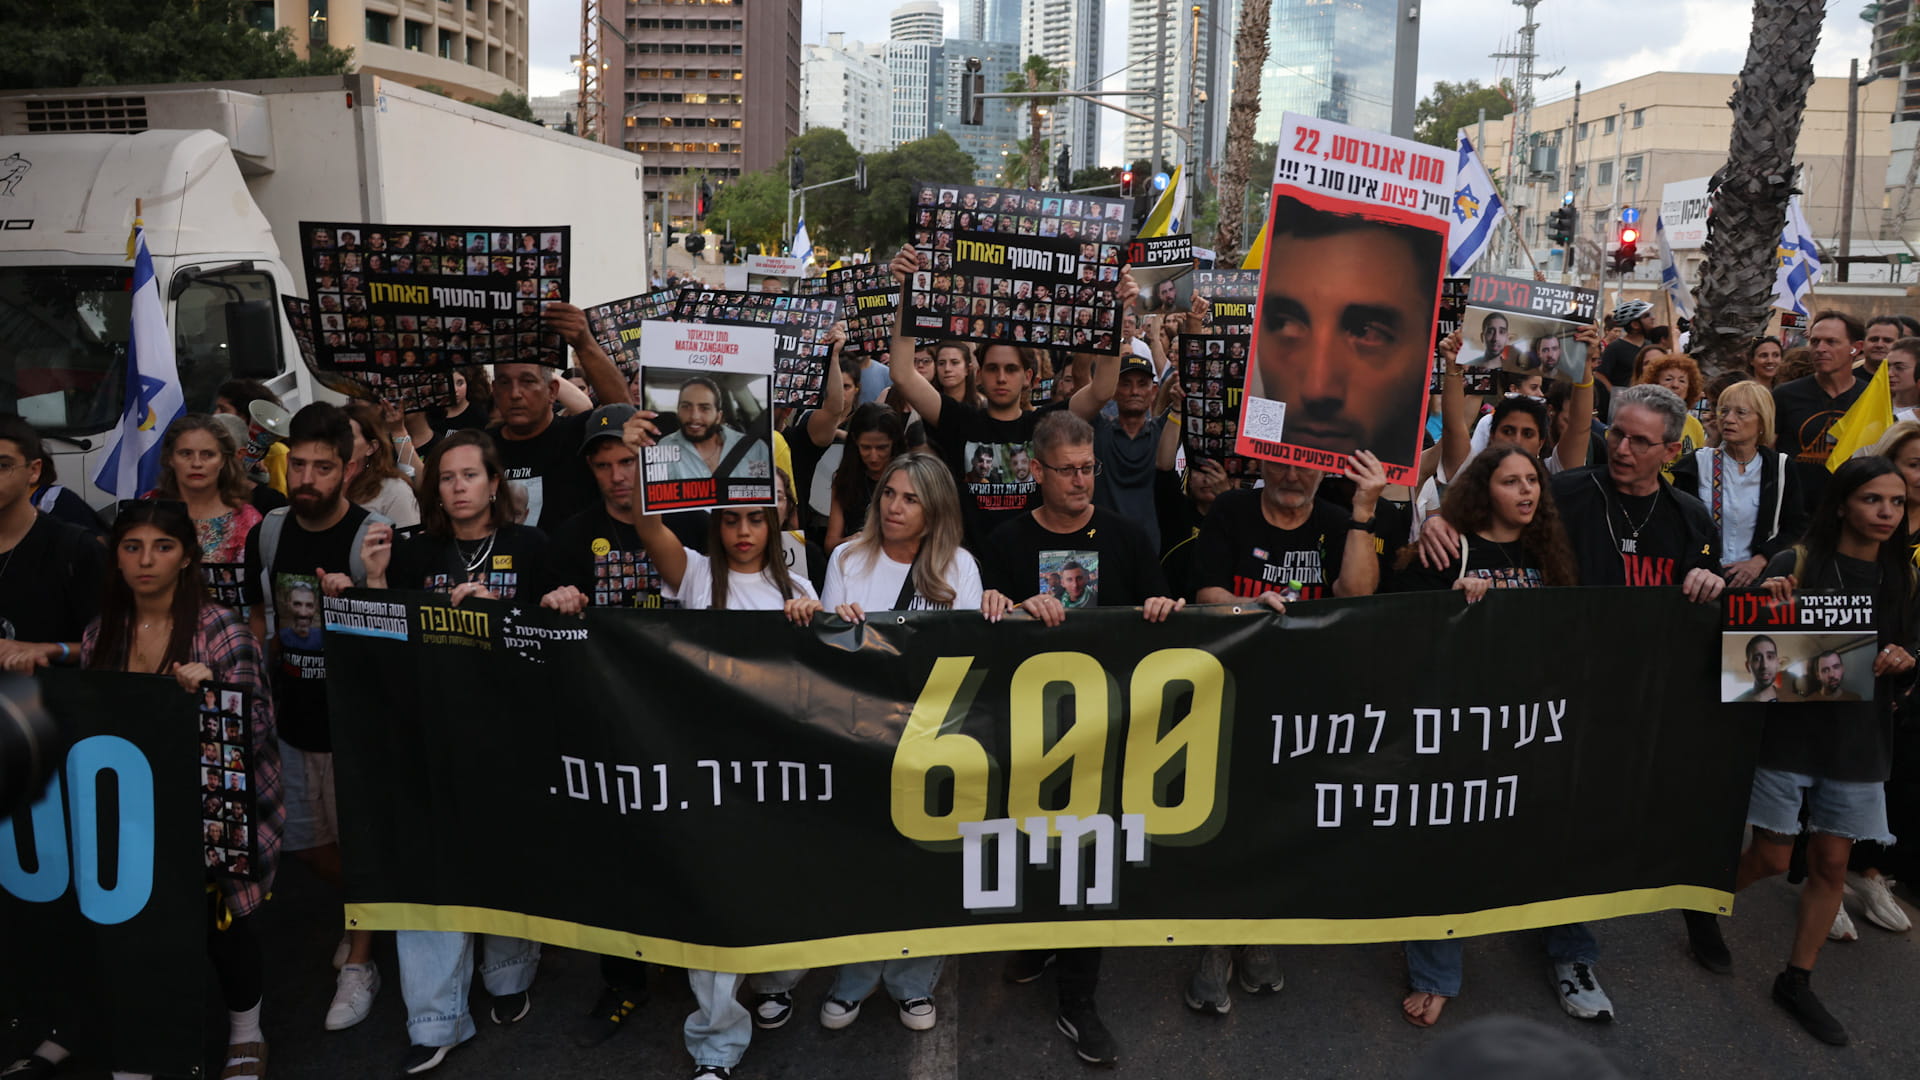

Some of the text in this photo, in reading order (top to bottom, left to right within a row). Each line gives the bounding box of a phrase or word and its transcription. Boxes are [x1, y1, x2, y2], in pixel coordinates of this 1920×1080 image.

[1293, 126, 1445, 185] מתן אנגרסט, 22
[1318, 167, 1345, 192] סוג
[1347, 174, 1378, 200] אינו
[1380, 182, 1418, 209] פצוע
[1421, 189, 1450, 216] חייל
[1147, 238, 1191, 249] גיא ואביתר
[956, 239, 1076, 275] עד החטוף האחרון
[1147, 247, 1191, 263] זועקים
[369, 282, 512, 310] עד החטוף האחרון
[857, 294, 888, 311] האחרון
[1472, 275, 1593, 318] זועקים הצילו!
[1535, 286, 1595, 304] גיא ואביתר
[1214, 302, 1247, 318] האחרון
[675, 340, 739, 355] MATAN ZANGAUKER
[782, 335, 797, 351] עד
[645, 445, 680, 463] BRING
[1293, 448, 1335, 468] פצועים
[646, 463, 668, 482] HIM
[648, 483, 679, 502] HOME
[682, 478, 717, 499] NOW!
[1800, 595, 1872, 606] גיא ואביתר
[1800, 607, 1873, 627] זועקים
[503, 635, 542, 650] רייכמן
[515, 624, 589, 641] אוניברסיטת
[1271, 698, 1567, 764] צעירים למען
[891, 648, 1224, 841] 600
[1315, 774, 1518, 828] החטופים
[958, 813, 1146, 909] ימים
